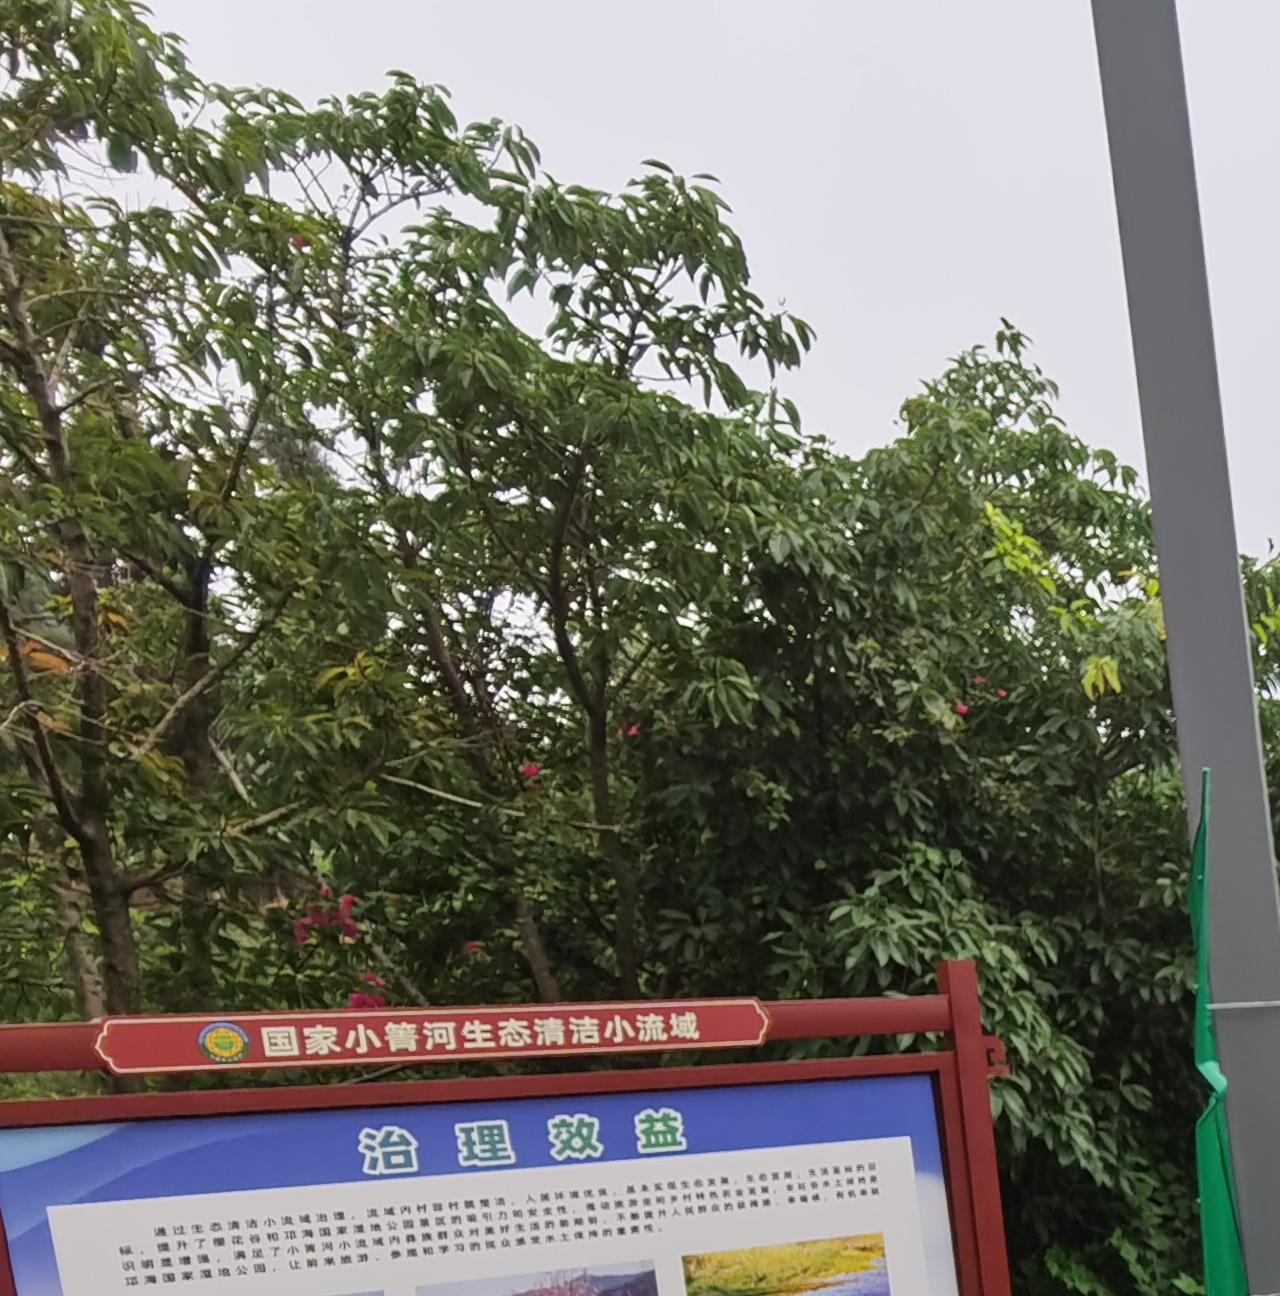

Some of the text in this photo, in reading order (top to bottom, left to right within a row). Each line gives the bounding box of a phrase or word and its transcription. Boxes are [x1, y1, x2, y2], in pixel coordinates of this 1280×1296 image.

[260, 1011, 701, 1058] 国家小箐河生态清洁小流域
[357, 1107, 688, 1174] 治理效益
